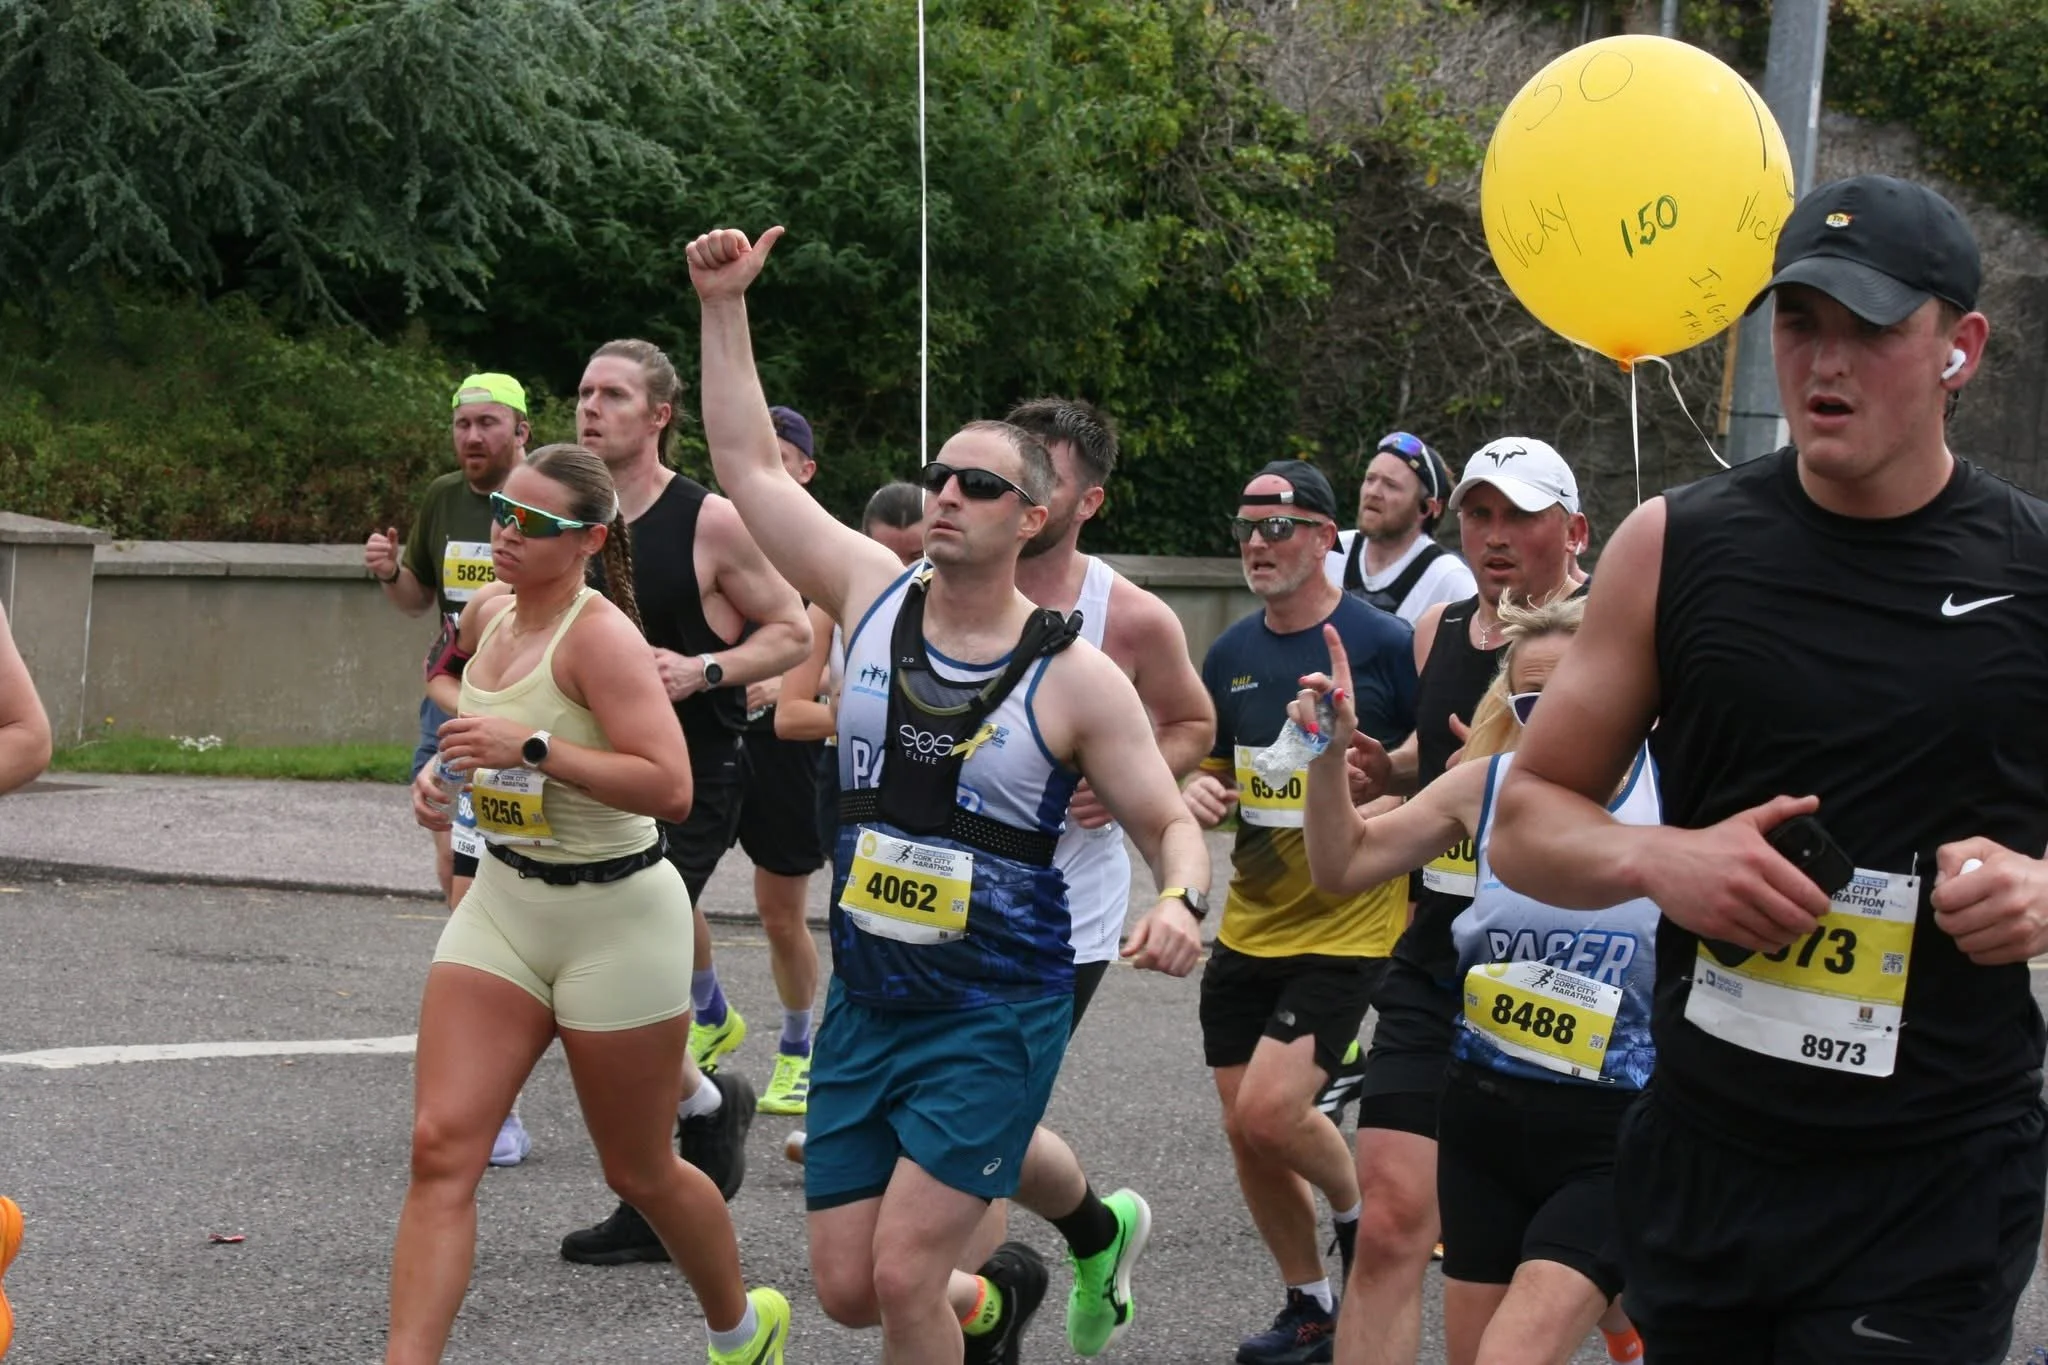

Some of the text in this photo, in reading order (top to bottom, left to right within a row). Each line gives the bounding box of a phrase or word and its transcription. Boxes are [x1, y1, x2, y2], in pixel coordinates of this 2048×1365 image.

[1620, 194, 1678, 258] 1.50
[1736, 191, 1780, 250] Vick
[1497, 192, 1582, 269] Vicky
[457, 564, 496, 582] 5825
[905, 750, 938, 765] ELITE
[481, 796, 525, 826] 5256
[457, 840, 476, 855] 1598
[912, 860, 954, 872] MARATHON
[913, 853, 932, 862] CORK
[934, 857, 952, 866] CITY
[865, 871, 938, 913] 4062
[1831, 892, 1885, 909] RATHON
[1852, 885, 1881, 897] CITY
[1551, 985, 1598, 1005] MARATHON
[1553, 980, 1597, 996] CORK CITY
[1491, 993, 1577, 1045] 8488
[1801, 1034, 1867, 1066] 8973
